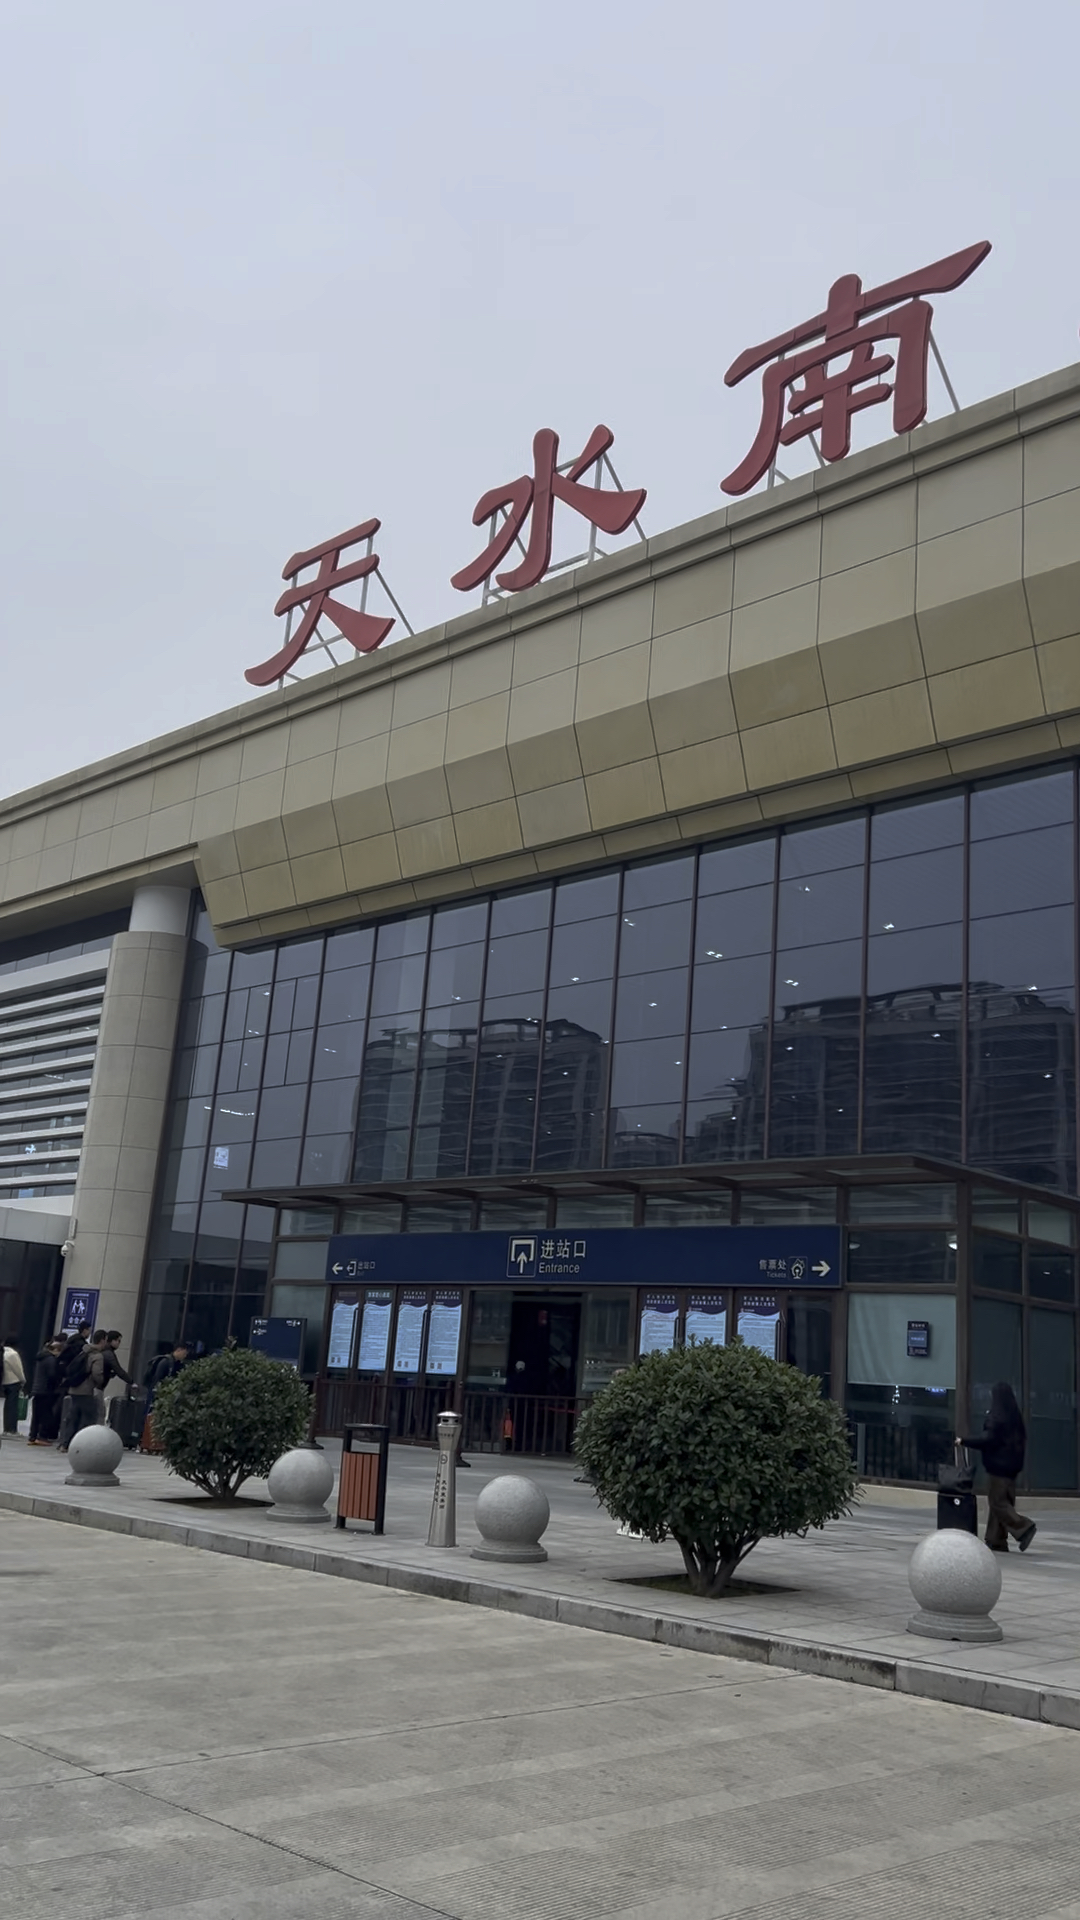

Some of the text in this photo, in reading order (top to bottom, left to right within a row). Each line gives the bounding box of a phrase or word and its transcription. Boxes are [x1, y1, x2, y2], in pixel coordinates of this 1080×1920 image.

[244, 240, 992, 687] 天水南
[540, 1238, 587, 1259] 进站口
[538, 1261, 581, 1274] Entrance
[759, 1259, 787, 1270] 售票处
[766, 1270, 787, 1279] Tickets
